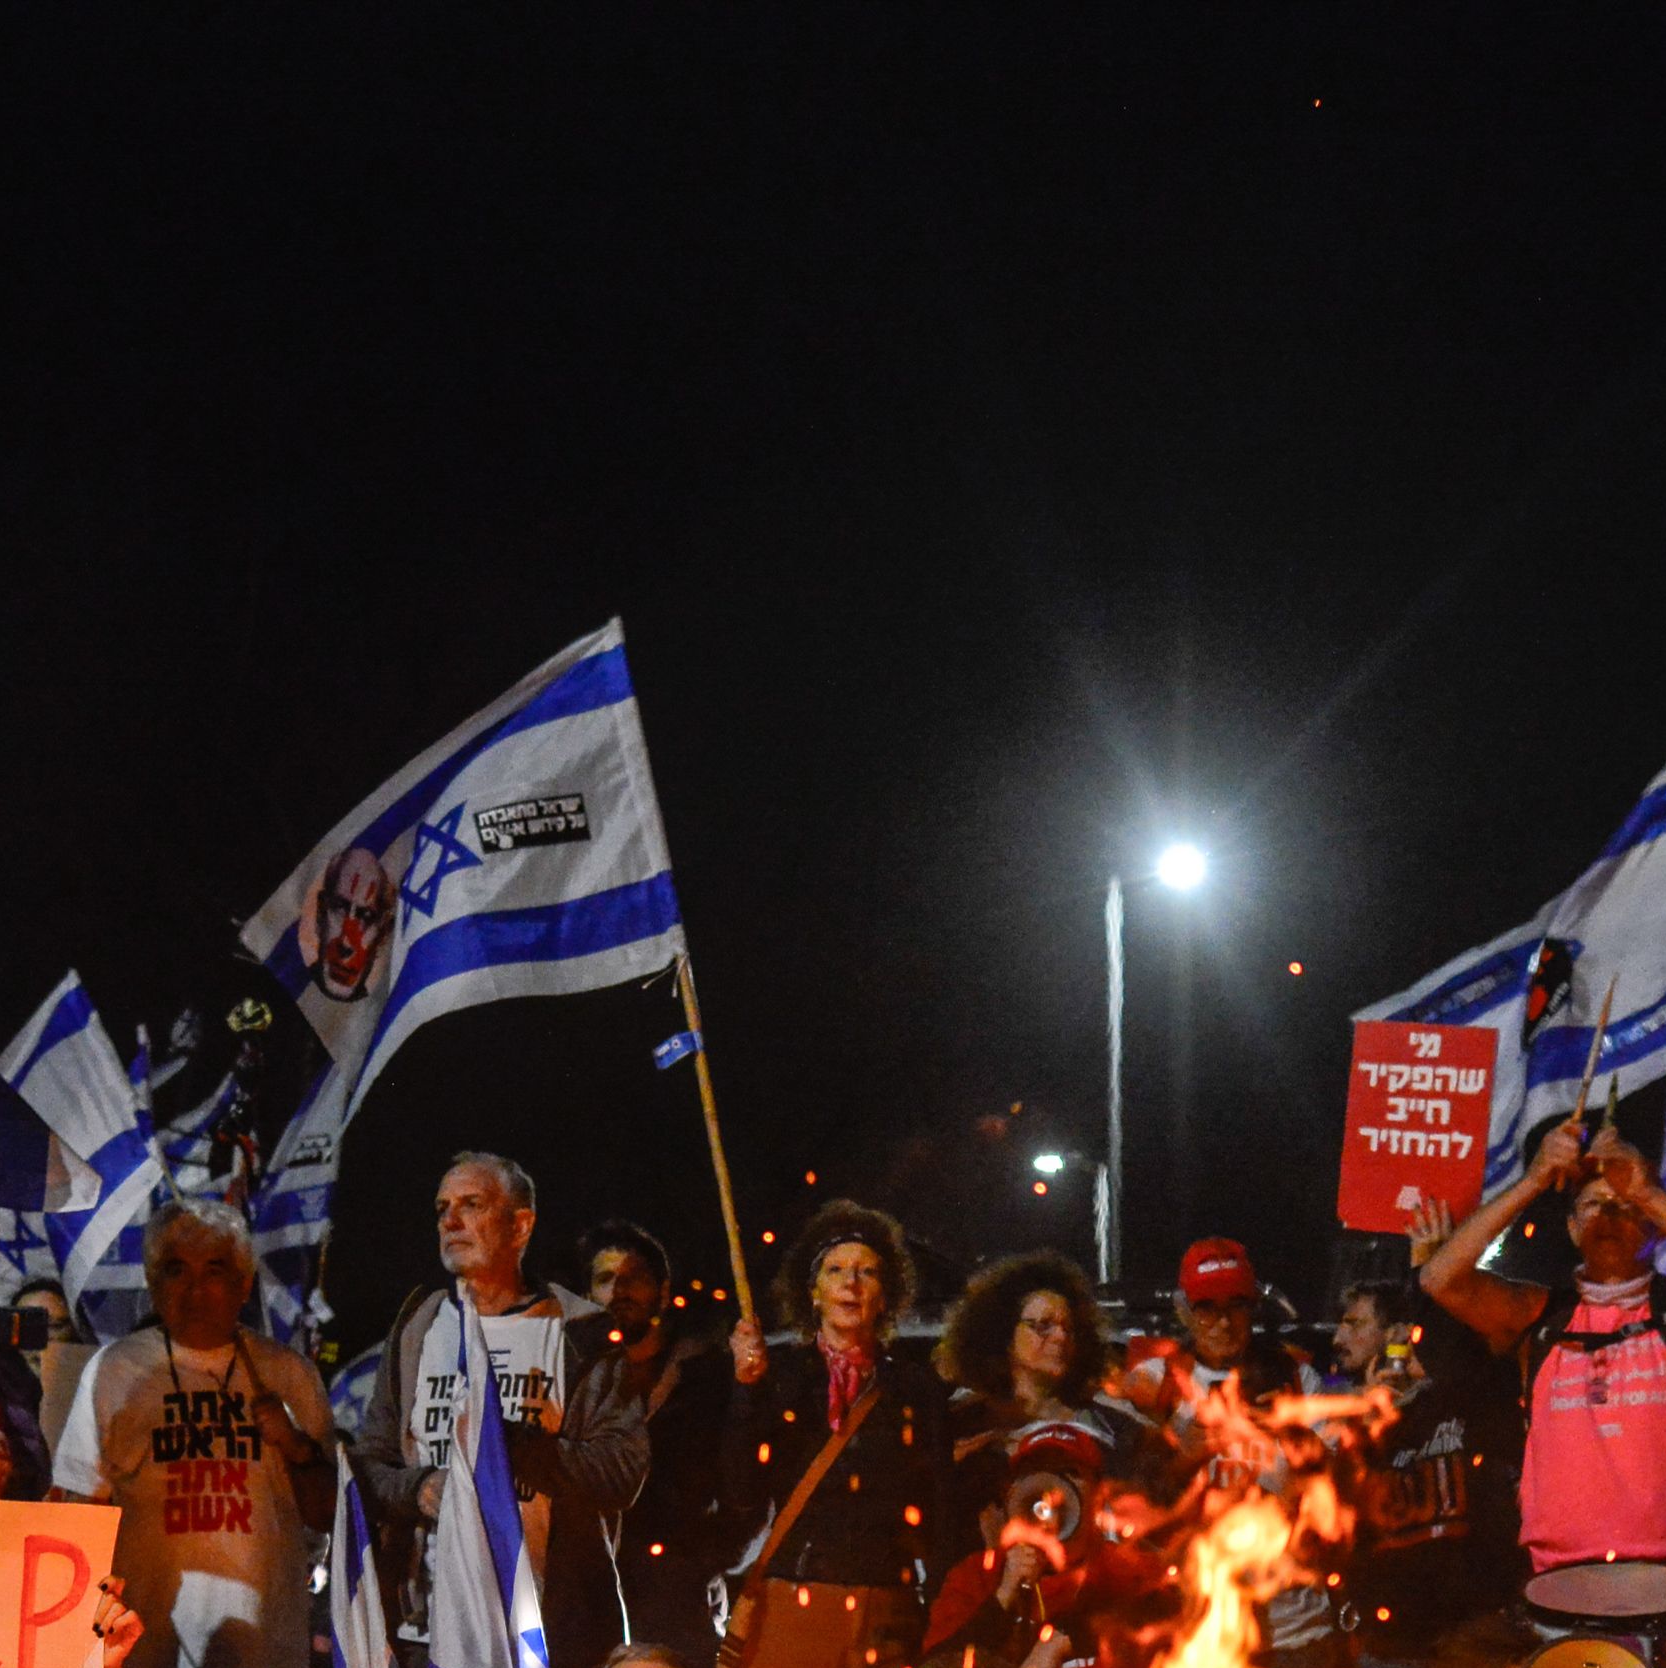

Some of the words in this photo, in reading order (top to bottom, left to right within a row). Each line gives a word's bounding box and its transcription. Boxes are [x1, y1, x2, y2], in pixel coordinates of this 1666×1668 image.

[1409, 1031, 1443, 1058] מי
[1358, 1061, 1486, 1095] שהפקיר
[1386, 1096, 1451, 1125] חייב
[1358, 1126, 1473, 1160] להחזיר
[498, 1371, 554, 1399] לוחמ
[163, 1391, 247, 1424] אתה
[151, 1425, 261, 1463] הראש
[166, 1460, 248, 1496] אתה
[163, 1496, 252, 1534] אשם
